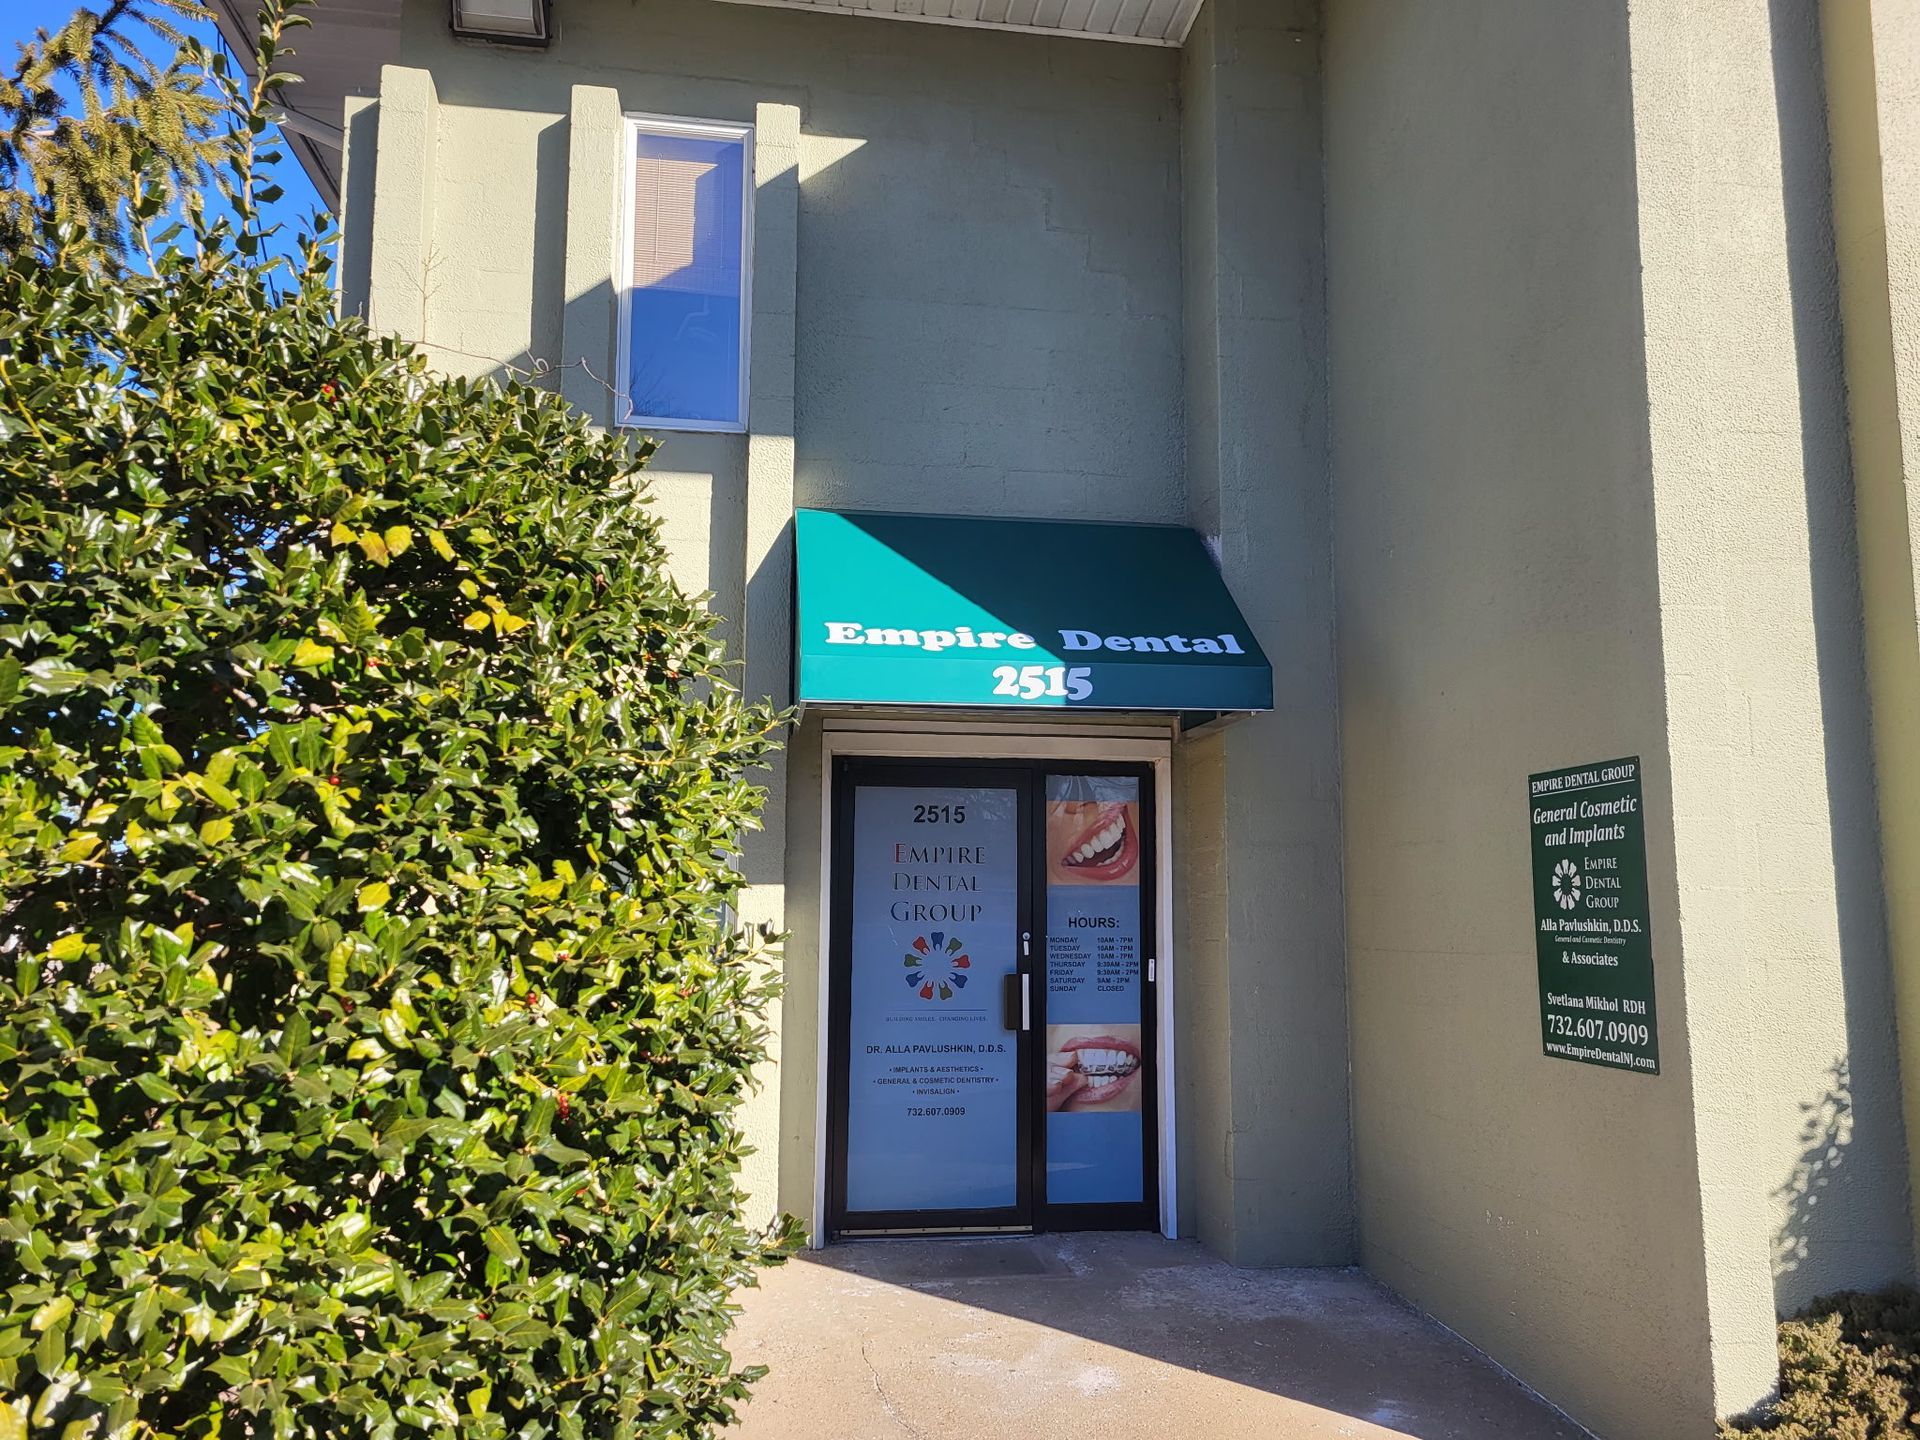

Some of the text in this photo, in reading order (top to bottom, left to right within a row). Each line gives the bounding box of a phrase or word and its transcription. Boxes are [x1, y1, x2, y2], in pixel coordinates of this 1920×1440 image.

[823, 622, 1245, 654] Empire Dental
[992, 666, 1093, 701] 2515
[1532, 764, 1635, 793] EMPIRE DENTAL GROUP
[913, 805, 965, 824] 2515
[1534, 795, 1637, 824] General Cosmetic
[1545, 824, 1625, 847] and Implants
[895, 843, 985, 864] EMPIRE
[1584, 857, 1617, 870] EMPIRE
[894, 872, 982, 891] DENTAL
[1585, 876, 1621, 889] DENTAL
[1586, 895, 1619, 908] GROUP
[890, 902, 982, 922] GROUP
[1069, 917, 1119, 928] HOURS:
[1541, 919, 1642, 934] Alla Pavlushkin, D.D.S.
[1562, 951, 1618, 966] & Associates
[1548, 993, 1645, 1014] Svetlana Mikhol RDH
[1548, 1015, 1648, 1046] 732.607.0909
[913, 1045, 976, 1053] PAVLUSHKIN,
[978, 1045, 1006, 1053] D.D.S.
[1546, 1042, 1656, 1069] www.EmpireDentalNJ.com
[907, 1107, 966, 1116] 732.607.0909
